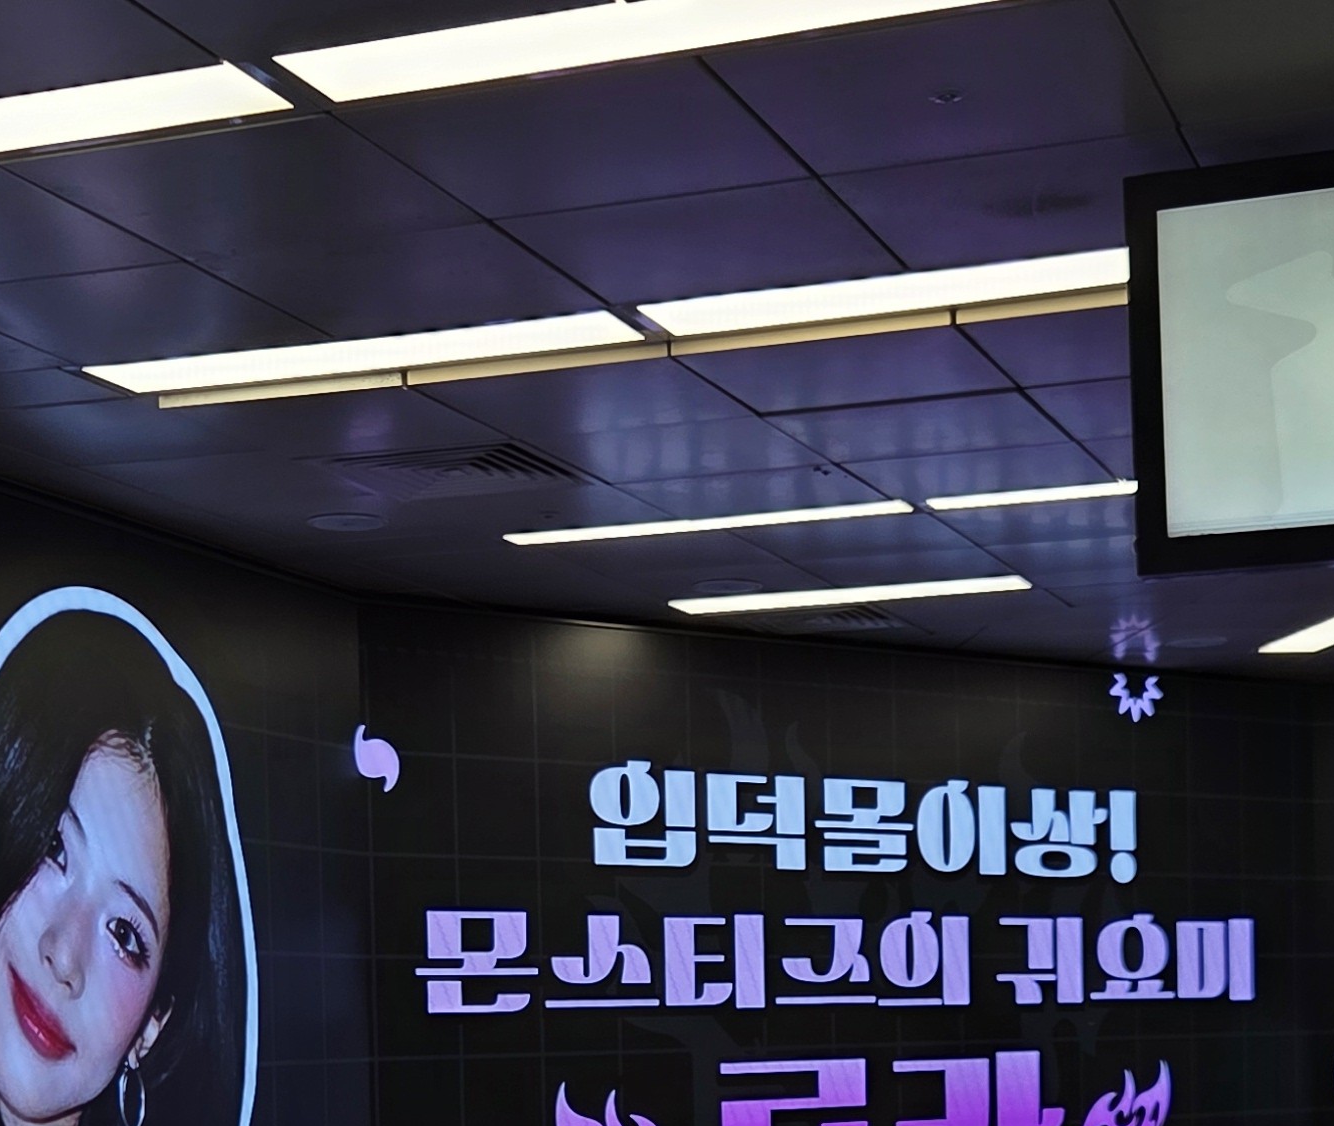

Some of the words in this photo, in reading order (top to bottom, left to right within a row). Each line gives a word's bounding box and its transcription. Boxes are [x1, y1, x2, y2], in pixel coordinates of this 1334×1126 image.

[588, 759, 1137, 884] 입덕몰이상!
[415, 910, 971, 1015] 몬스터즈의
[995, 911, 1255, 1005] 귀요미
